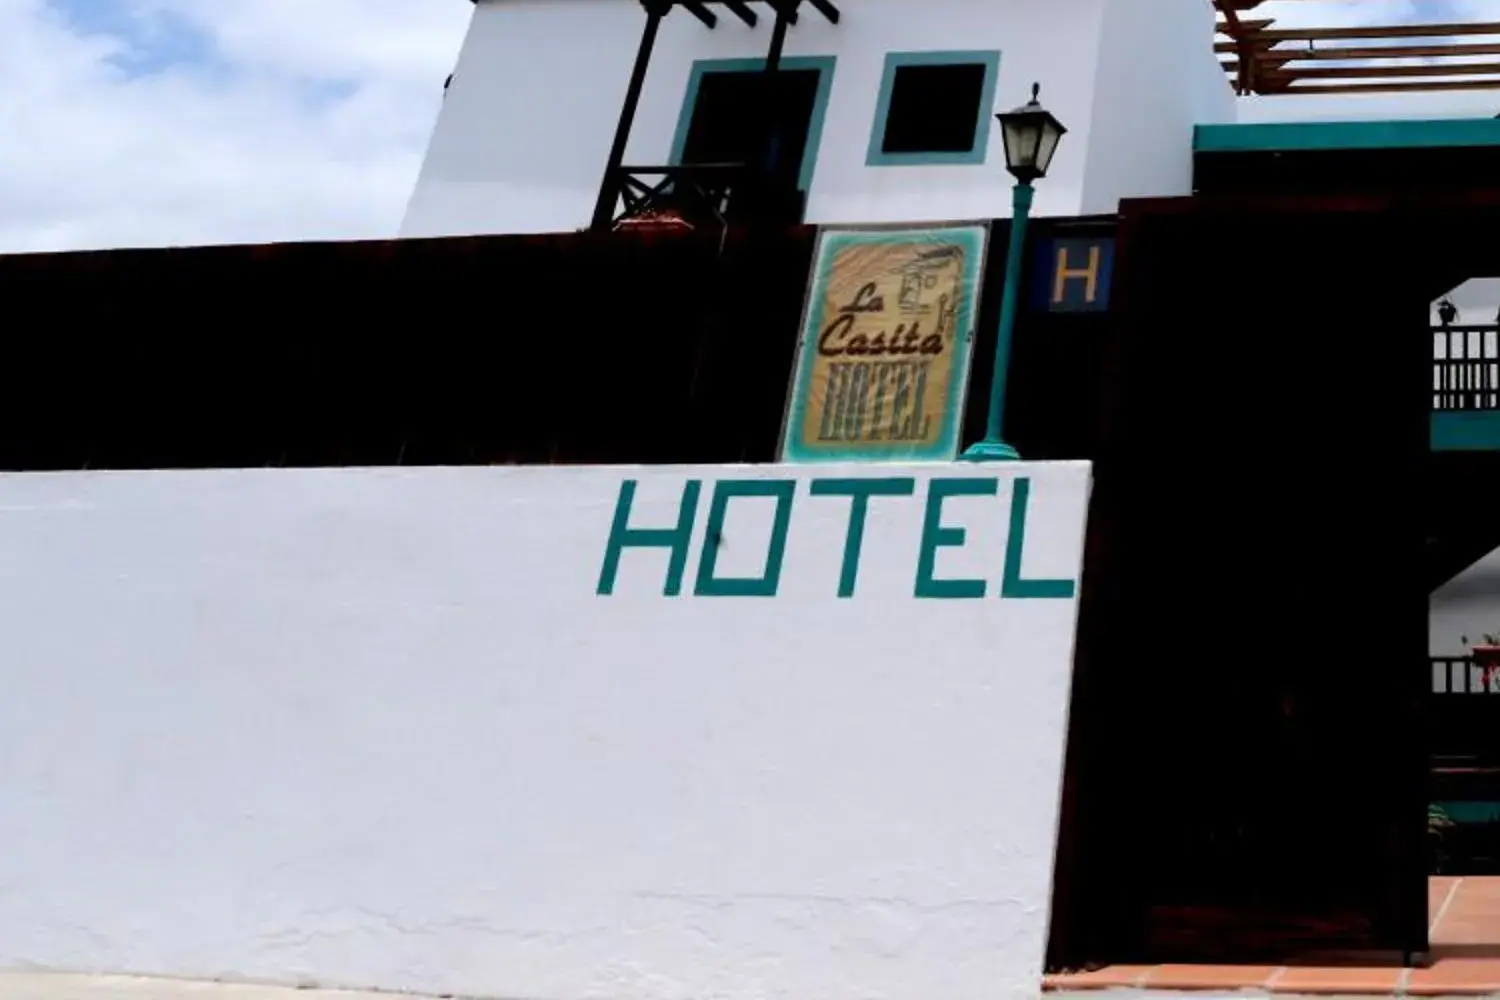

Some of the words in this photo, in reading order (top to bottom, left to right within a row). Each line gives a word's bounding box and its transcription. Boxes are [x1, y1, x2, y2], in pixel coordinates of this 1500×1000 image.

[840, 282, 884, 313] La
[1053, 246, 1099, 303] H
[818, 315, 944, 357] Casita
[817, 360, 932, 441] HOTEL
[596, 477, 1075, 598] HOTEL
